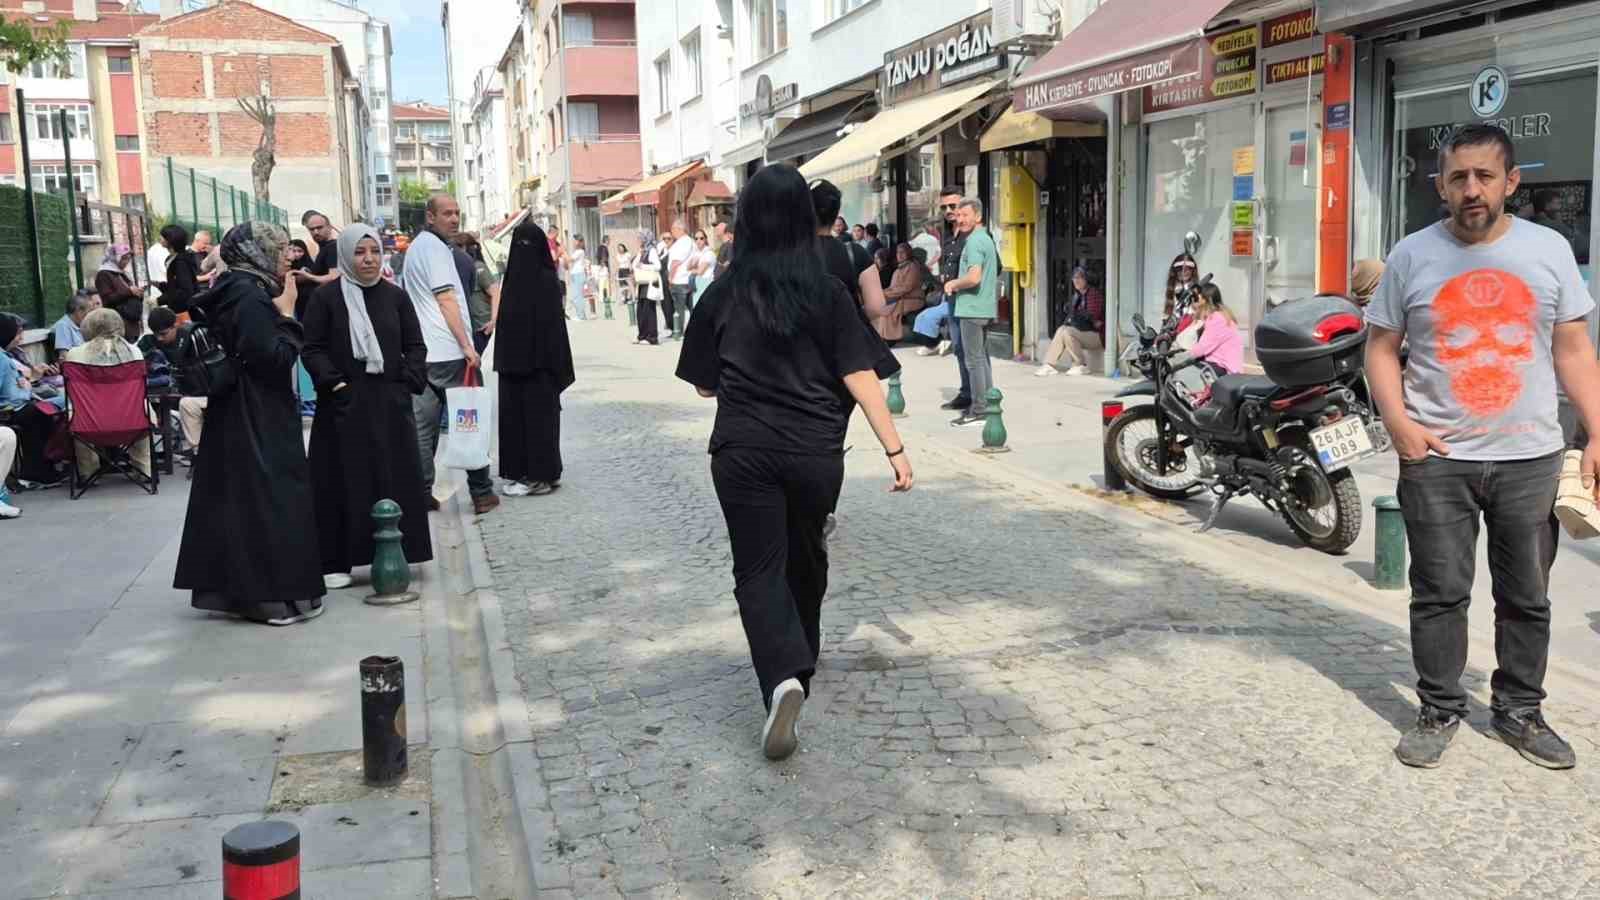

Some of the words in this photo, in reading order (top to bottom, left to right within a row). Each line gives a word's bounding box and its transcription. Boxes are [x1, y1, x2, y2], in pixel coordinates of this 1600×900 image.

[885, 48, 931, 88] TANJU
[935, 24, 992, 70] DOĞAN
[1025, 82, 1048, 108] HAN
[1088, 71, 1125, 92] OYUNCAK
[1131, 54, 1174, 83] FOTOKOPİ
[1331, 439, 1357, 458] 089
